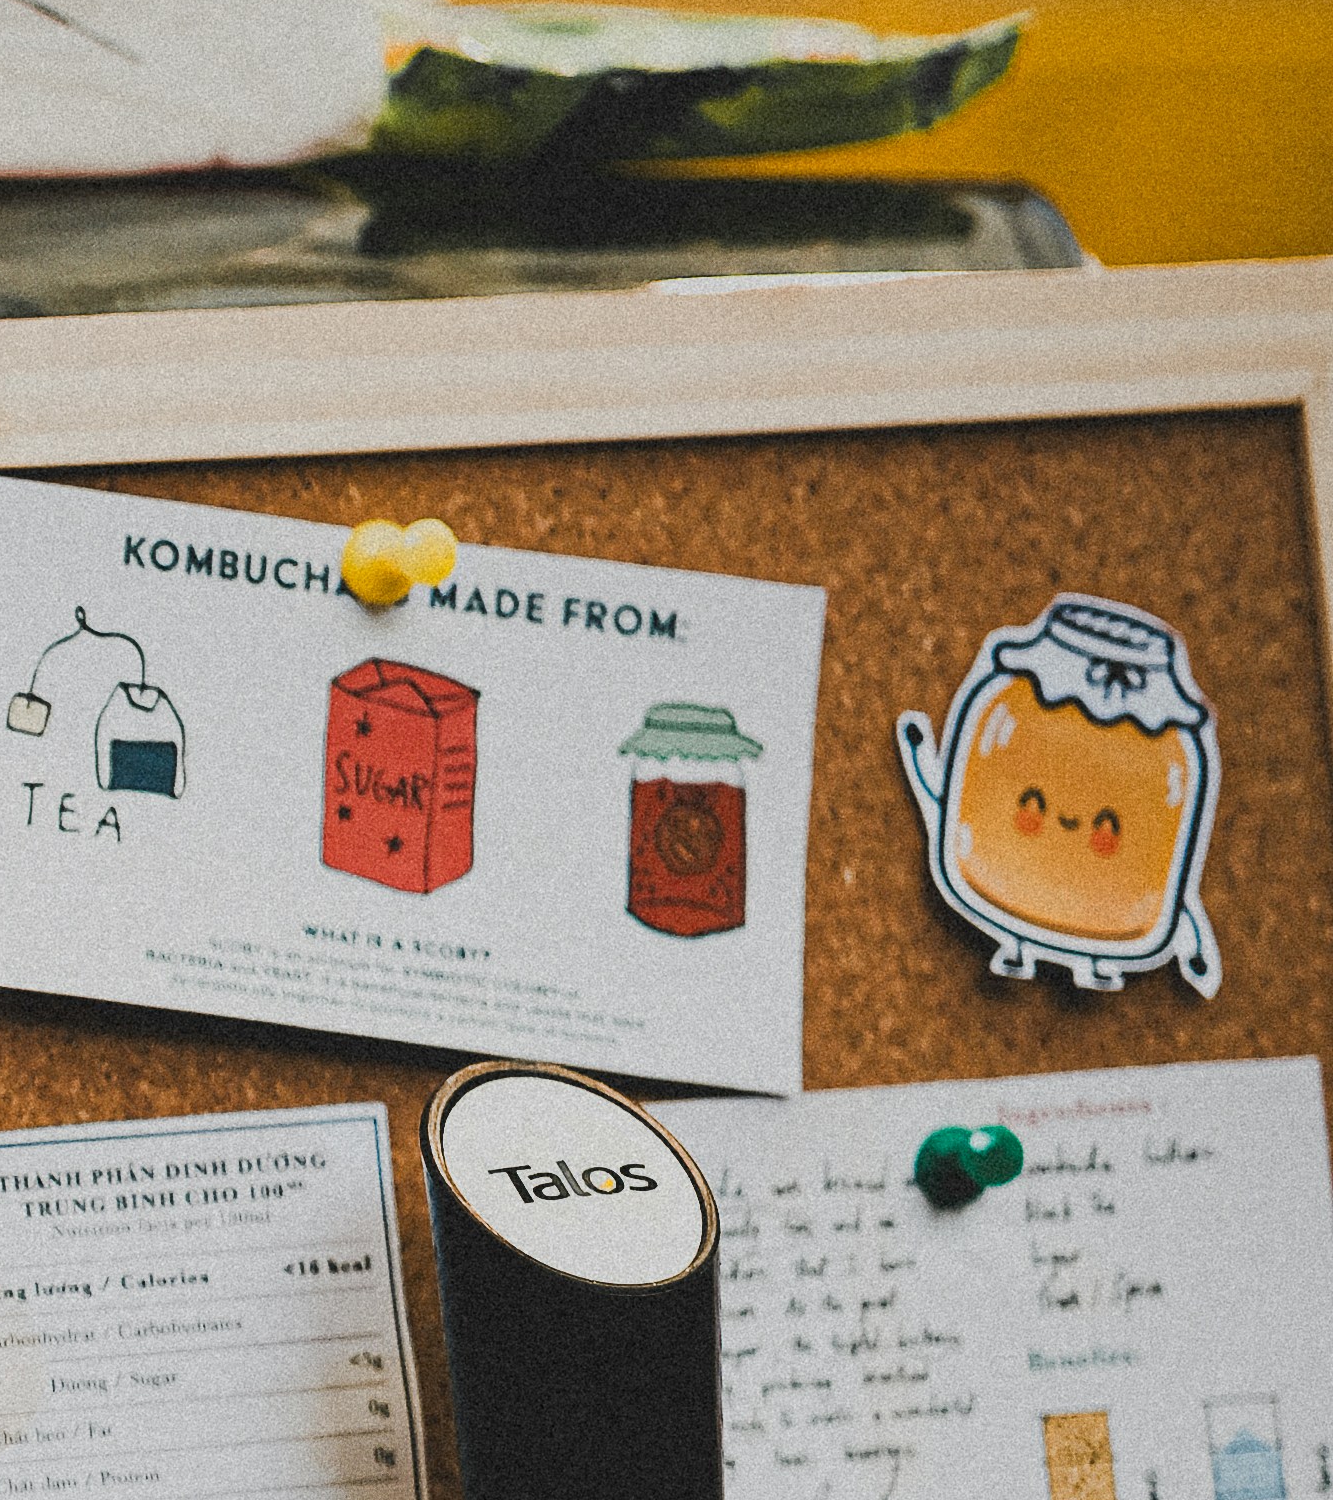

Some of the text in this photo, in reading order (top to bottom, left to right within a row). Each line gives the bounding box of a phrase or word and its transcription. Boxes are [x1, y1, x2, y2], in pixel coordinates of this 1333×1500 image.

[430, 583, 545, 625] MADE
[334, 751, 431, 811] SUGAR
[23, 781, 121, 843] TEA
[302, 925, 359, 947] WHAT
[391, 938, 403, 952] A
[165, 1159, 227, 1180] DINH
[488, 1159, 658, 1204] Talos
[24, 1186, 239, 1218] TRUNG CHO
[120, 1267, 210, 1289] Calories
[130, 1372, 177, 1390] Sugar
[88, 1420, 112, 1440] Fat
[99, 1469, 161, 1487] Protein
